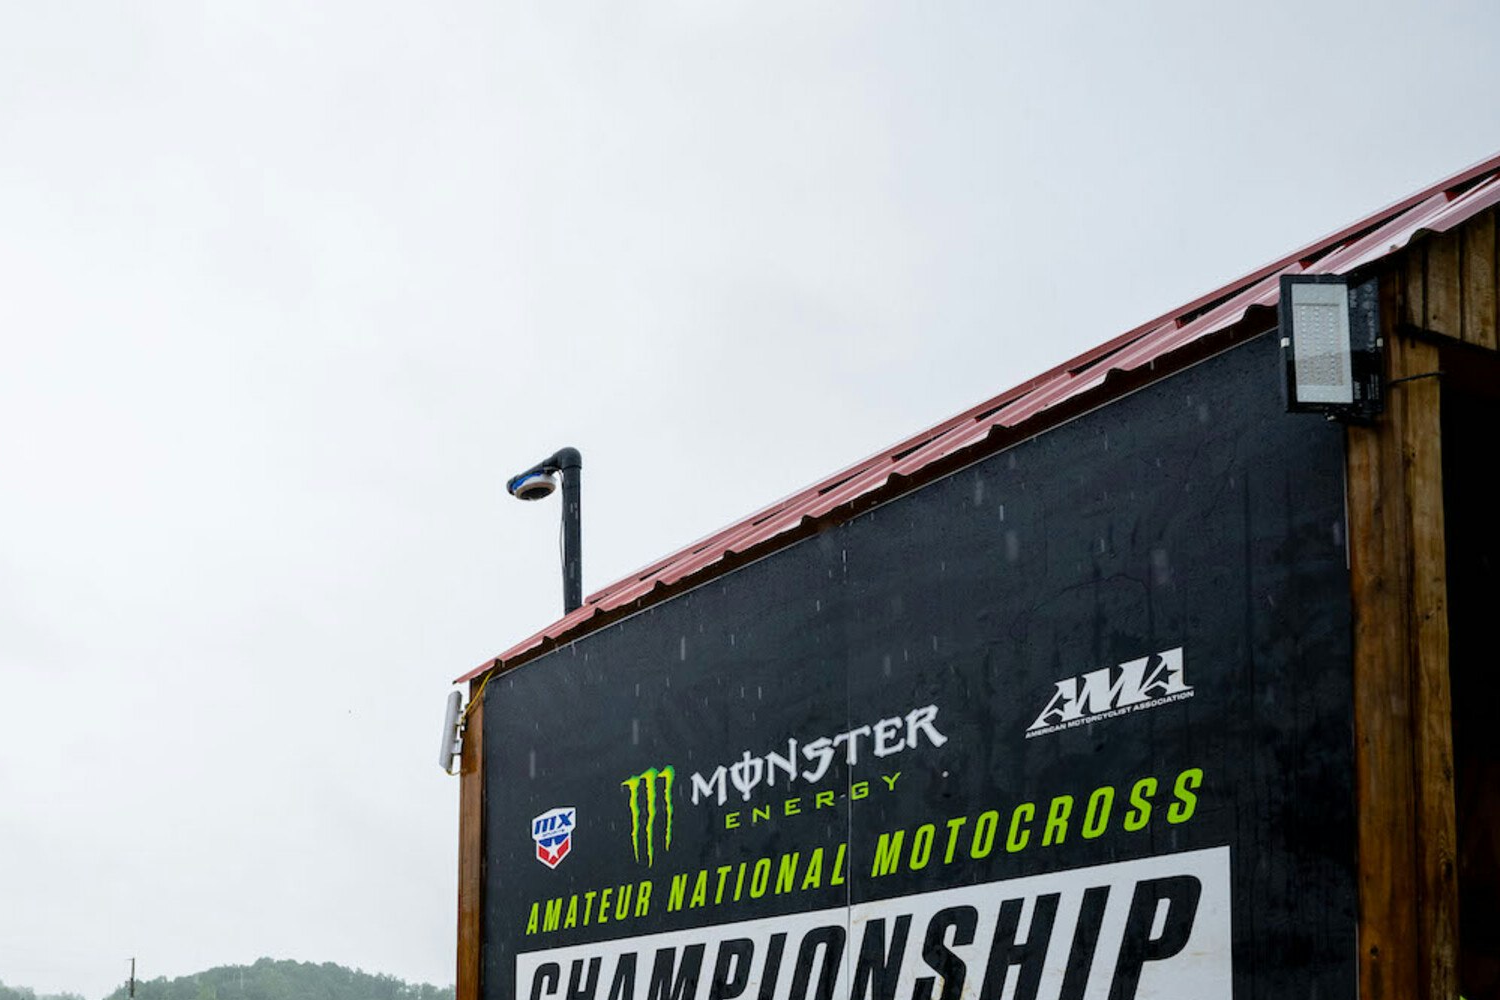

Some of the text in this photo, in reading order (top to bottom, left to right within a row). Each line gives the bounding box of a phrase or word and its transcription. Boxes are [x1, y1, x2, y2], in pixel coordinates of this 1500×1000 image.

[1025, 690, 1195, 739] AMERICAN MOTORCYCLIST ASSOCIATION
[1026, 647, 1194, 731] AMA
[691, 704, 948, 806] MONSTER
[535, 811, 574, 834] MX
[725, 772, 901, 829] ENERGY
[526, 768, 1204, 935] AMATEUR NATIONAL MOTOCROSS
